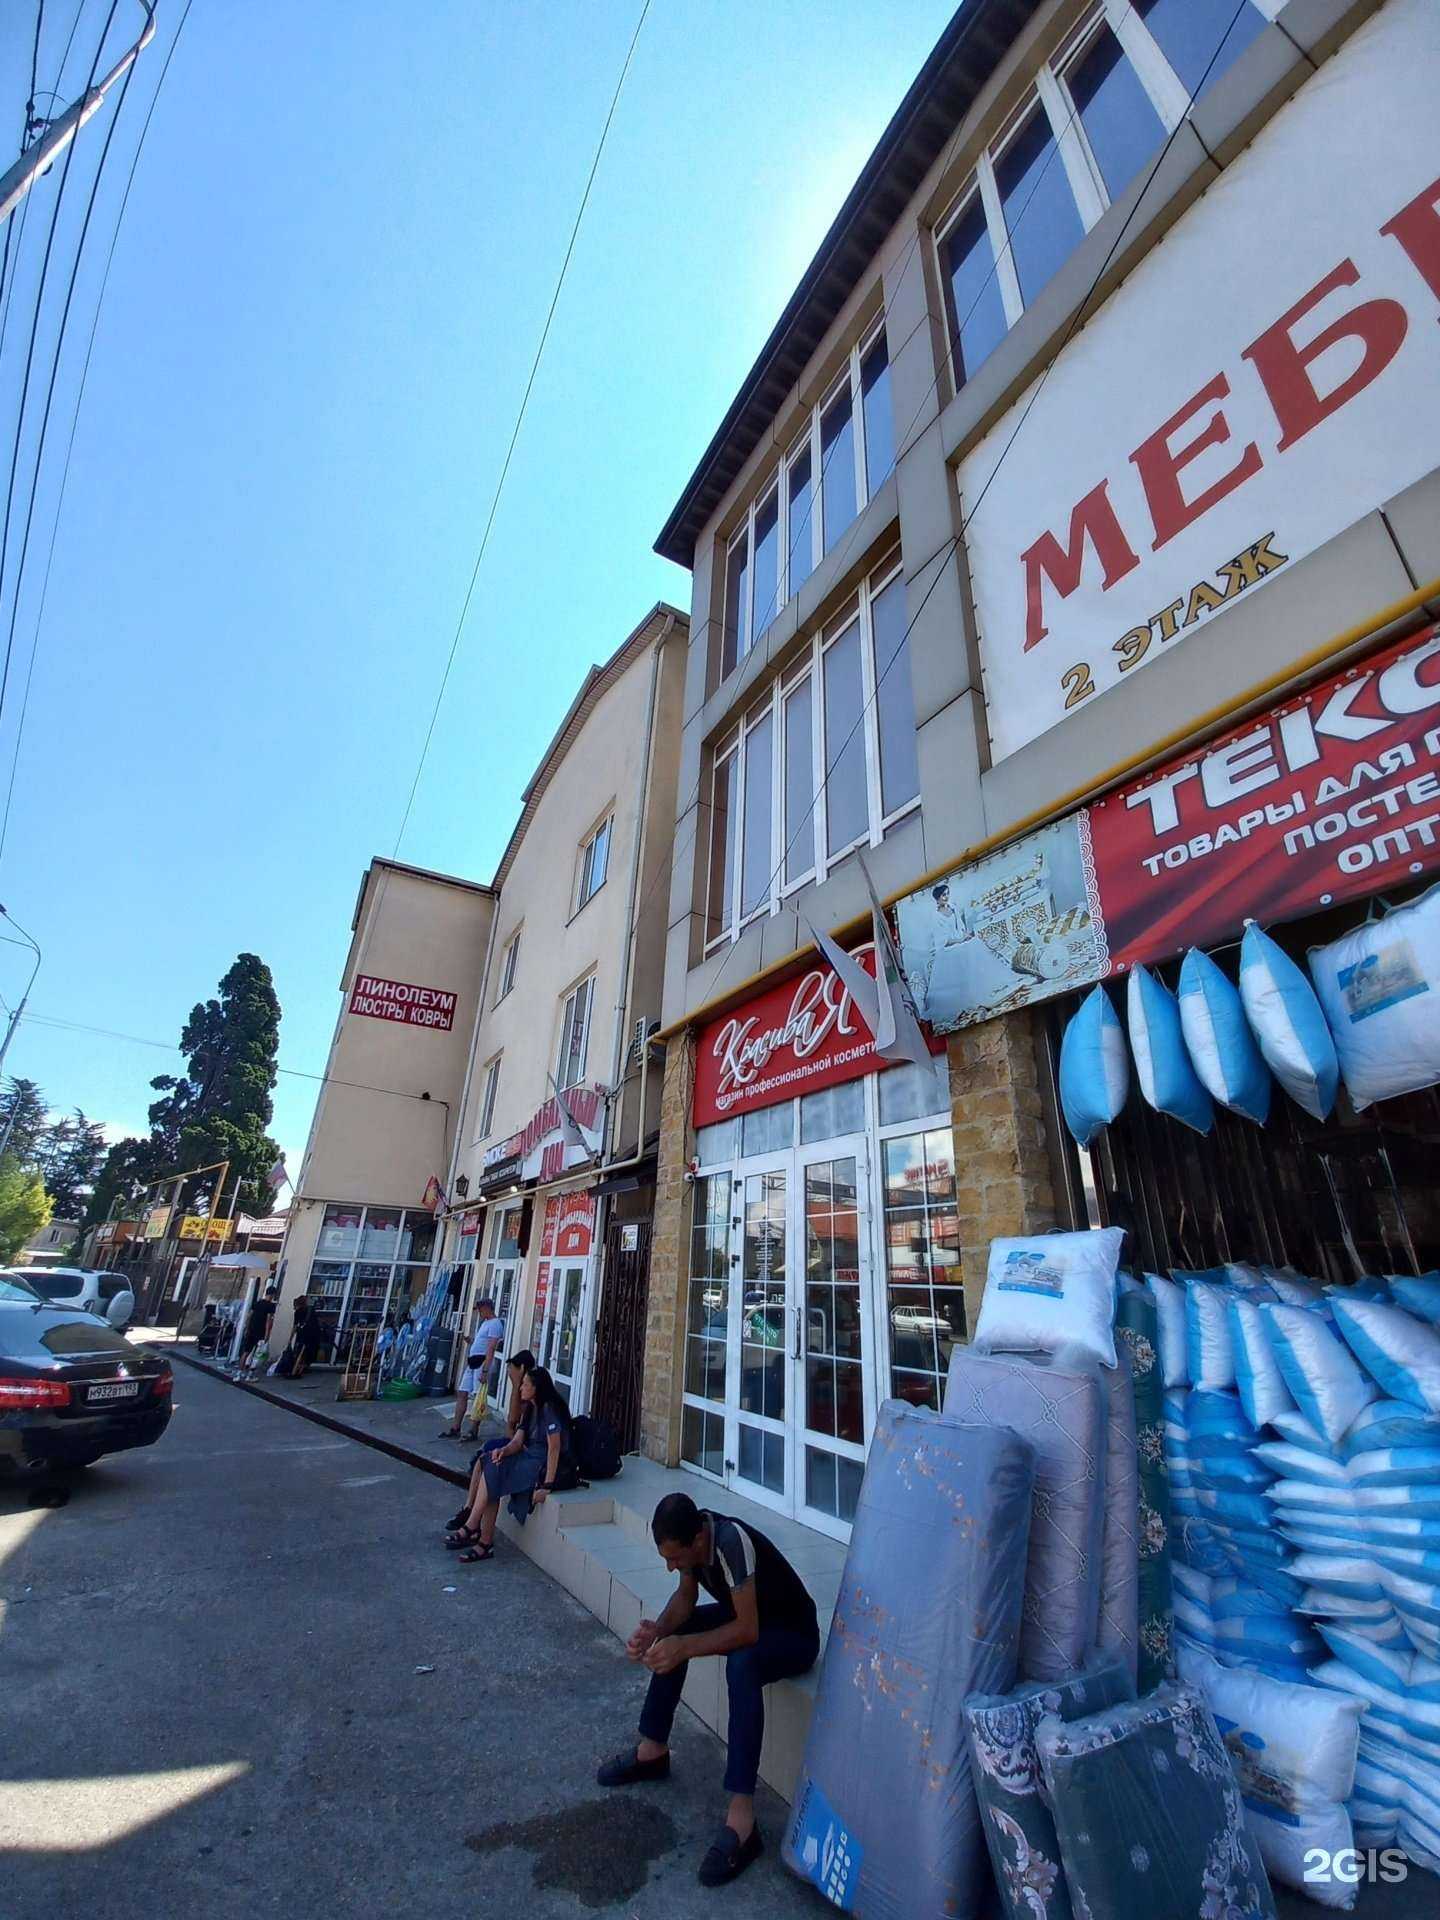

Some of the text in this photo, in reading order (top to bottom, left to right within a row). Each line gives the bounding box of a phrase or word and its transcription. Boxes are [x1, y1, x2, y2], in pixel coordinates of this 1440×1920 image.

[1060, 530, 1289, 711] 2 ЭТАЖ
[1141, 741, 1417, 878] ТОВАРЫ ДЛЯ
[352, 996, 452, 1030] ЛЮСТРЫ КОВРЫ
[357, 978, 454, 1011] ЛИНОЛЕУМ
[744, 1054, 832, 1099] профессиональной
